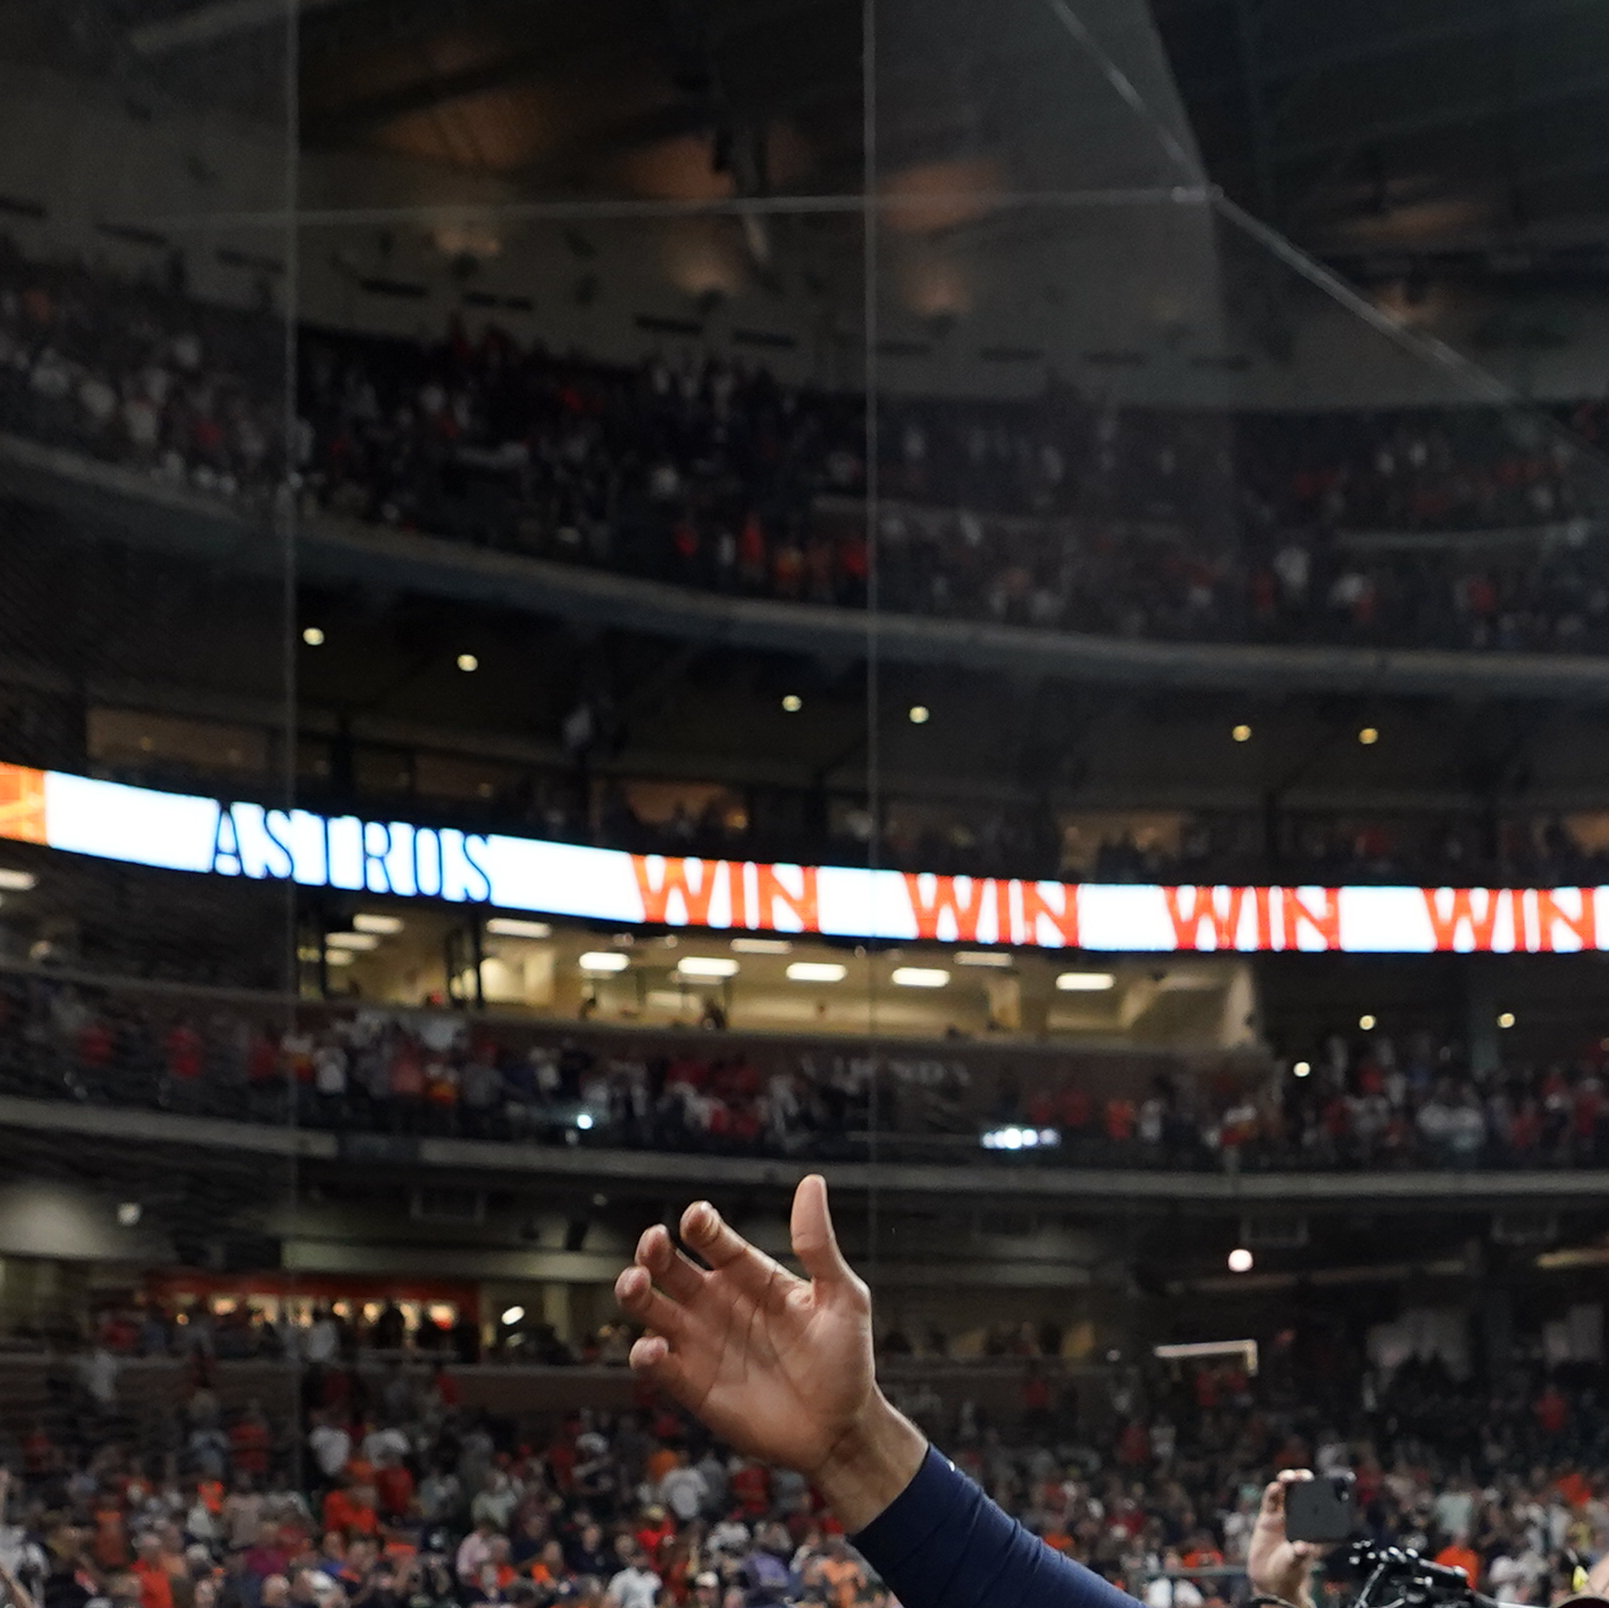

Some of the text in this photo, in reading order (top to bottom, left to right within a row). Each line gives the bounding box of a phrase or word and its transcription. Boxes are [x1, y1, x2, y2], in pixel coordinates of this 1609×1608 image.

[212, 802, 492, 903] ASTROS
[630, 855, 819, 932] WIN
[902, 871, 1080, 949] WIN
[1164, 885, 1341, 952] WIN
[1420, 887, 1598, 953] WIN
